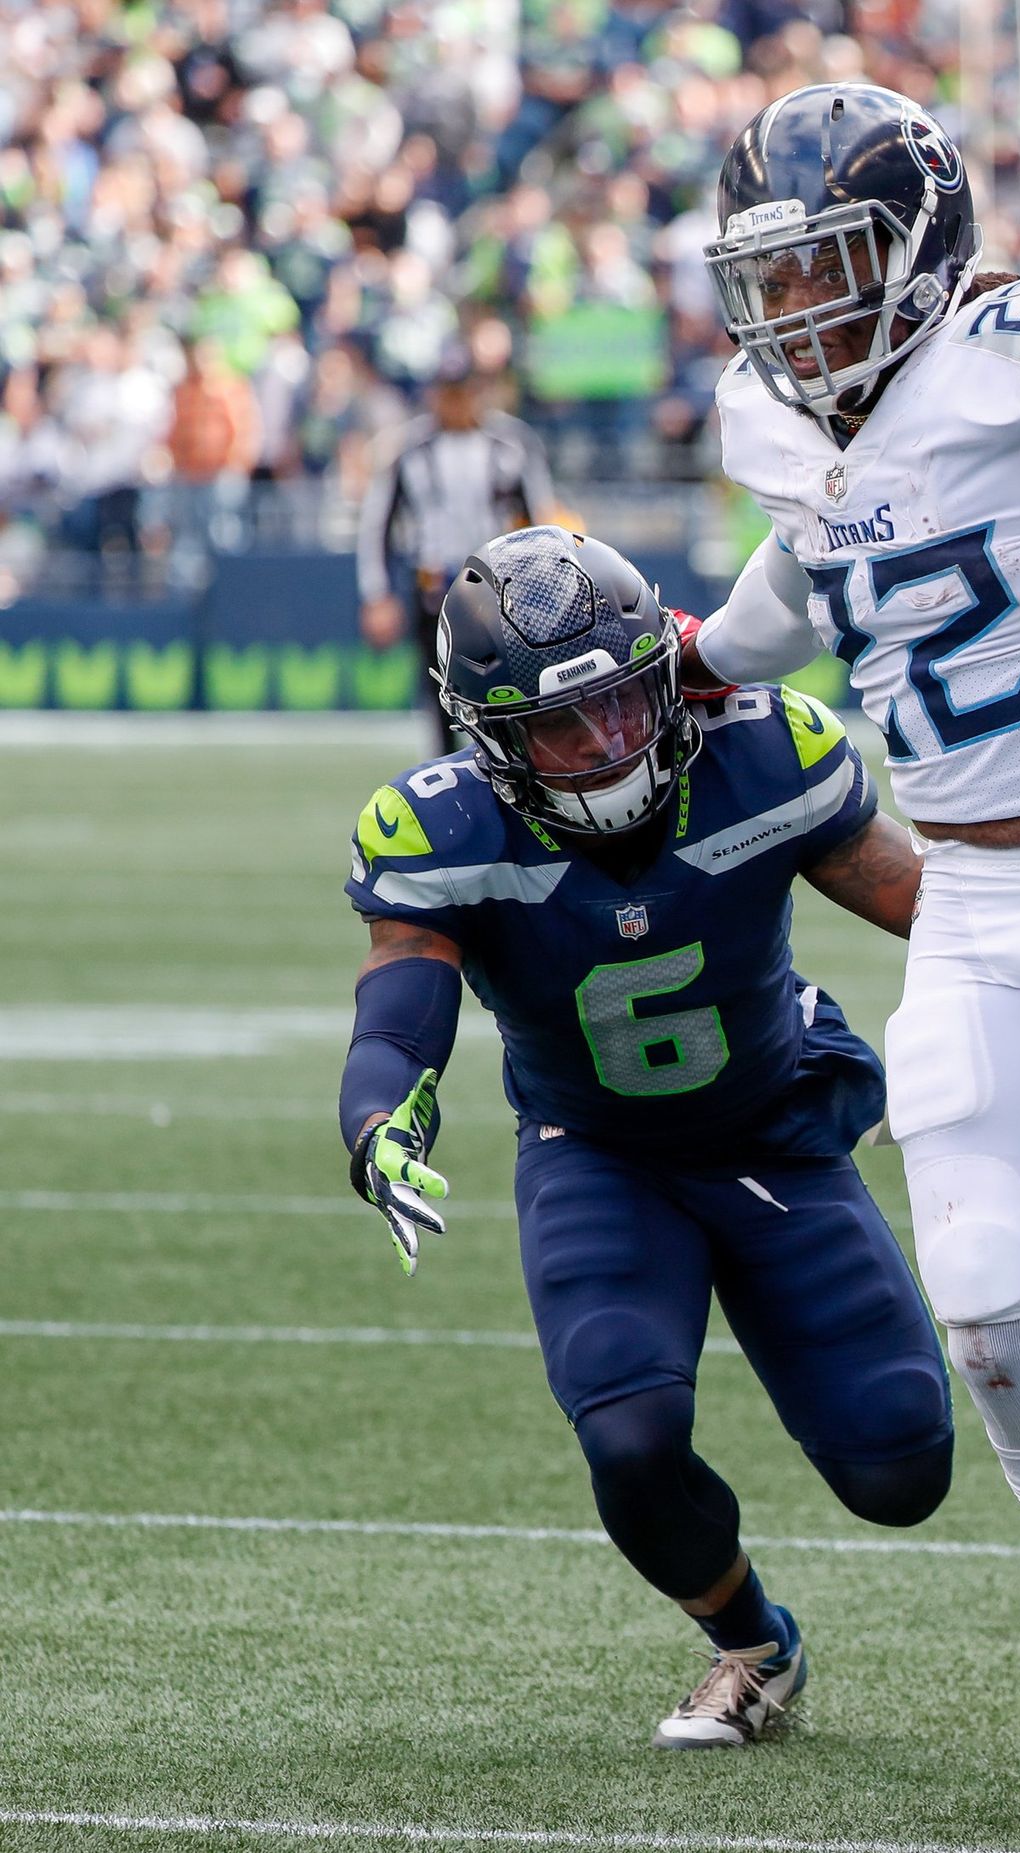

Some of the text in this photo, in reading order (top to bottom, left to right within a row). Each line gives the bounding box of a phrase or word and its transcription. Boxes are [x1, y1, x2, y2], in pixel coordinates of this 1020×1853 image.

[749, 206, 784, 226] TITANS
[825, 479, 845, 495] NFL
[817, 504, 895, 552] TITANS
[556, 658, 598, 683] SEAHAWKS
[711, 821, 793, 861] SEAHAWKS
[623, 920, 645, 934] NFL
[574, 940, 731, 1097] 6
